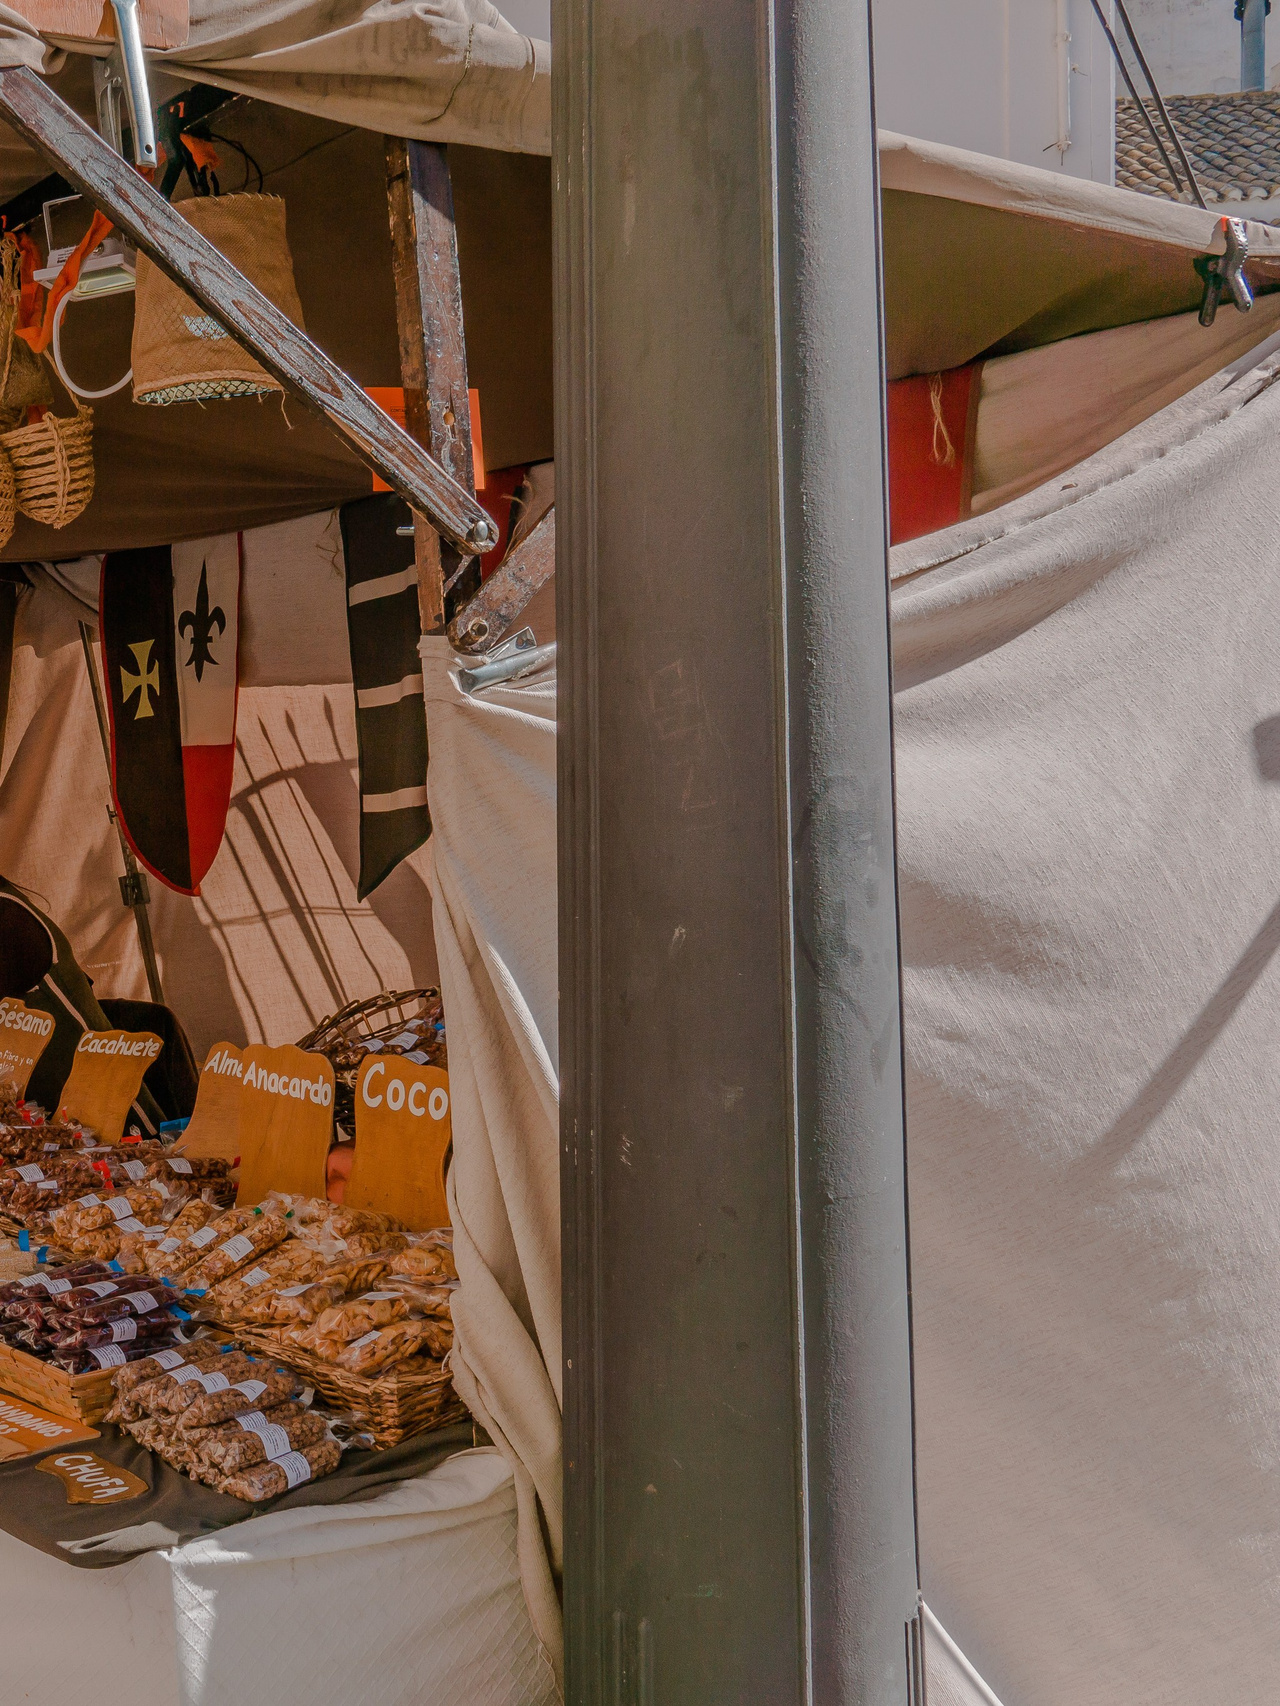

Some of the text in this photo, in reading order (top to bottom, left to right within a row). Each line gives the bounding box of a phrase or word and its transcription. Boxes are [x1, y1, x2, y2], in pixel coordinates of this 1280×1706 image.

[19, 1057, 24, 1066] y
[25, 1057, 34, 1066] en
[77, 1033, 161, 1057] Cacahuete
[204, 1050, 243, 1078] Alme
[243, 1061, 332, 1107] Anacardo
[363, 1062, 449, 1121] Coco
[54, 1455, 130, 1499] CHUFA
